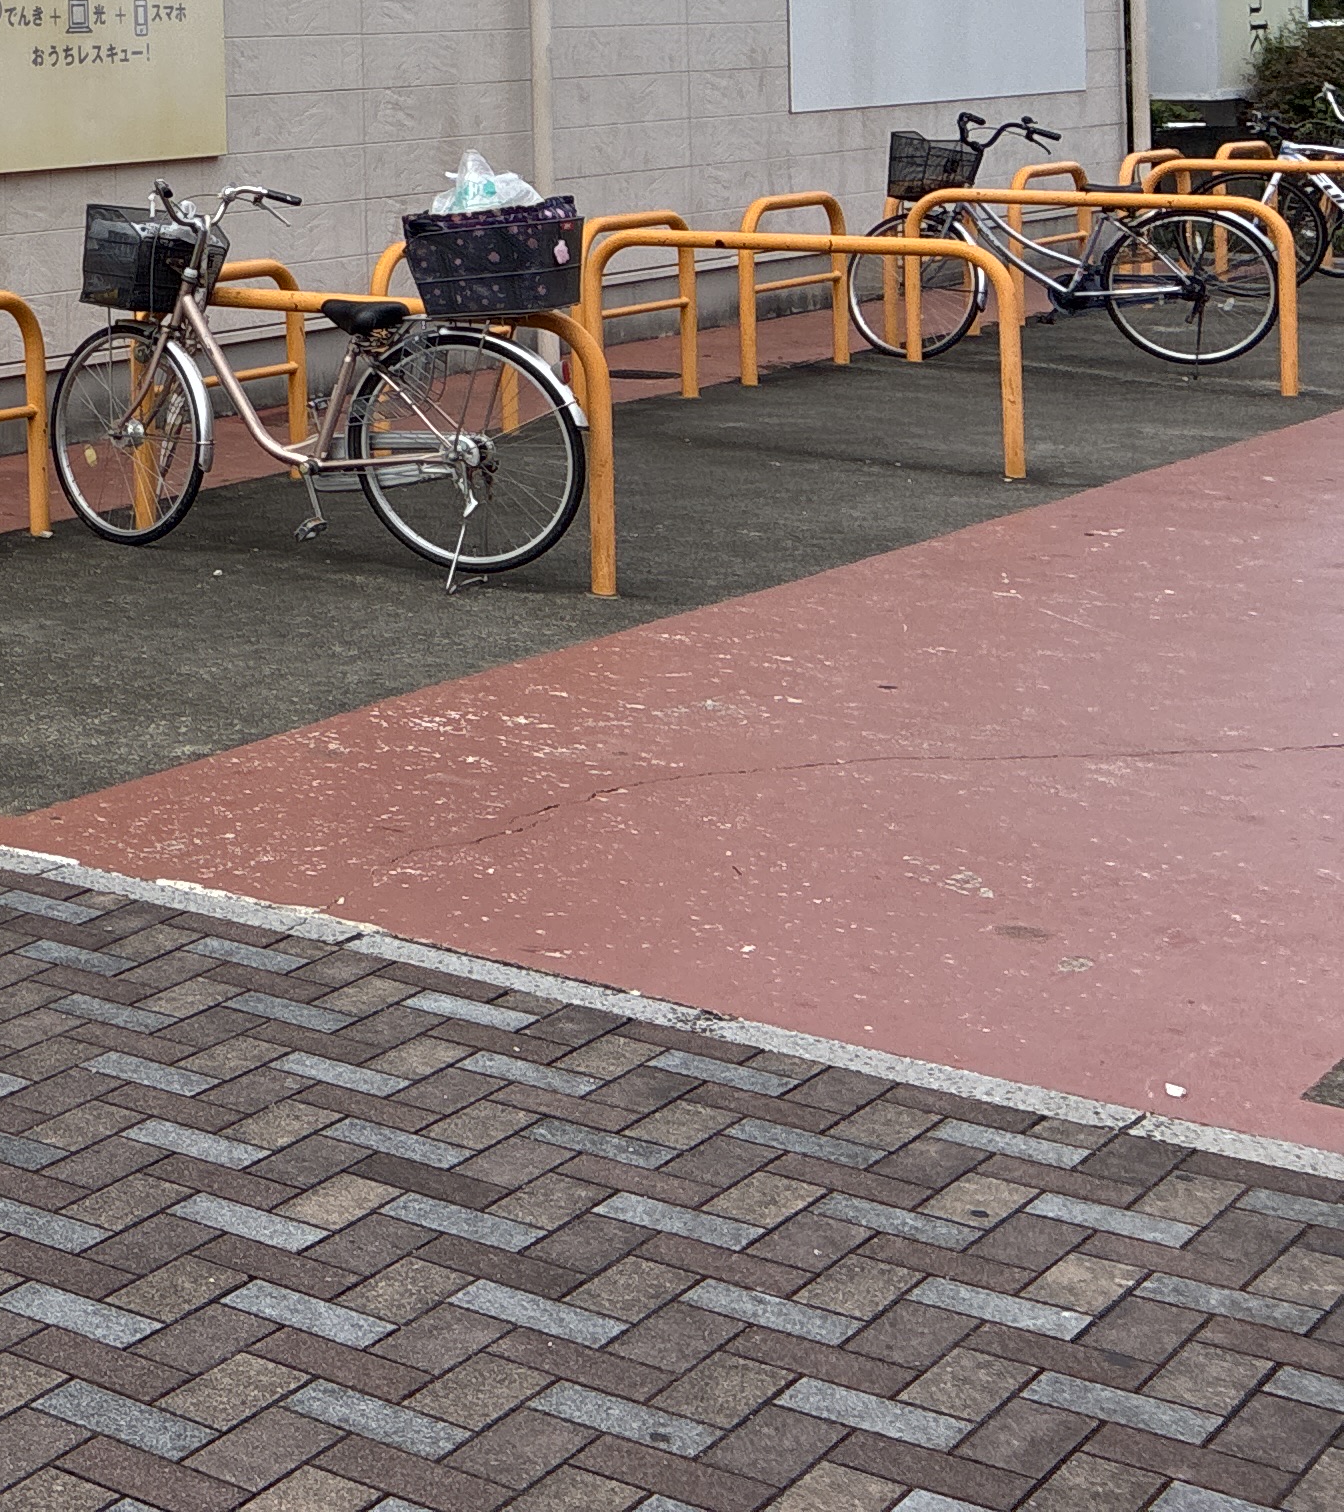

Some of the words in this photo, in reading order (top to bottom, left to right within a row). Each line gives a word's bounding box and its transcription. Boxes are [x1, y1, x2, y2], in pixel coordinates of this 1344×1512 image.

[4, 5, 45, 29] でんき
[93, 3, 108, 27] 光
[150, 3, 188, 23] スマホ
[31, 43, 152, 69] おうちレスキュー!
